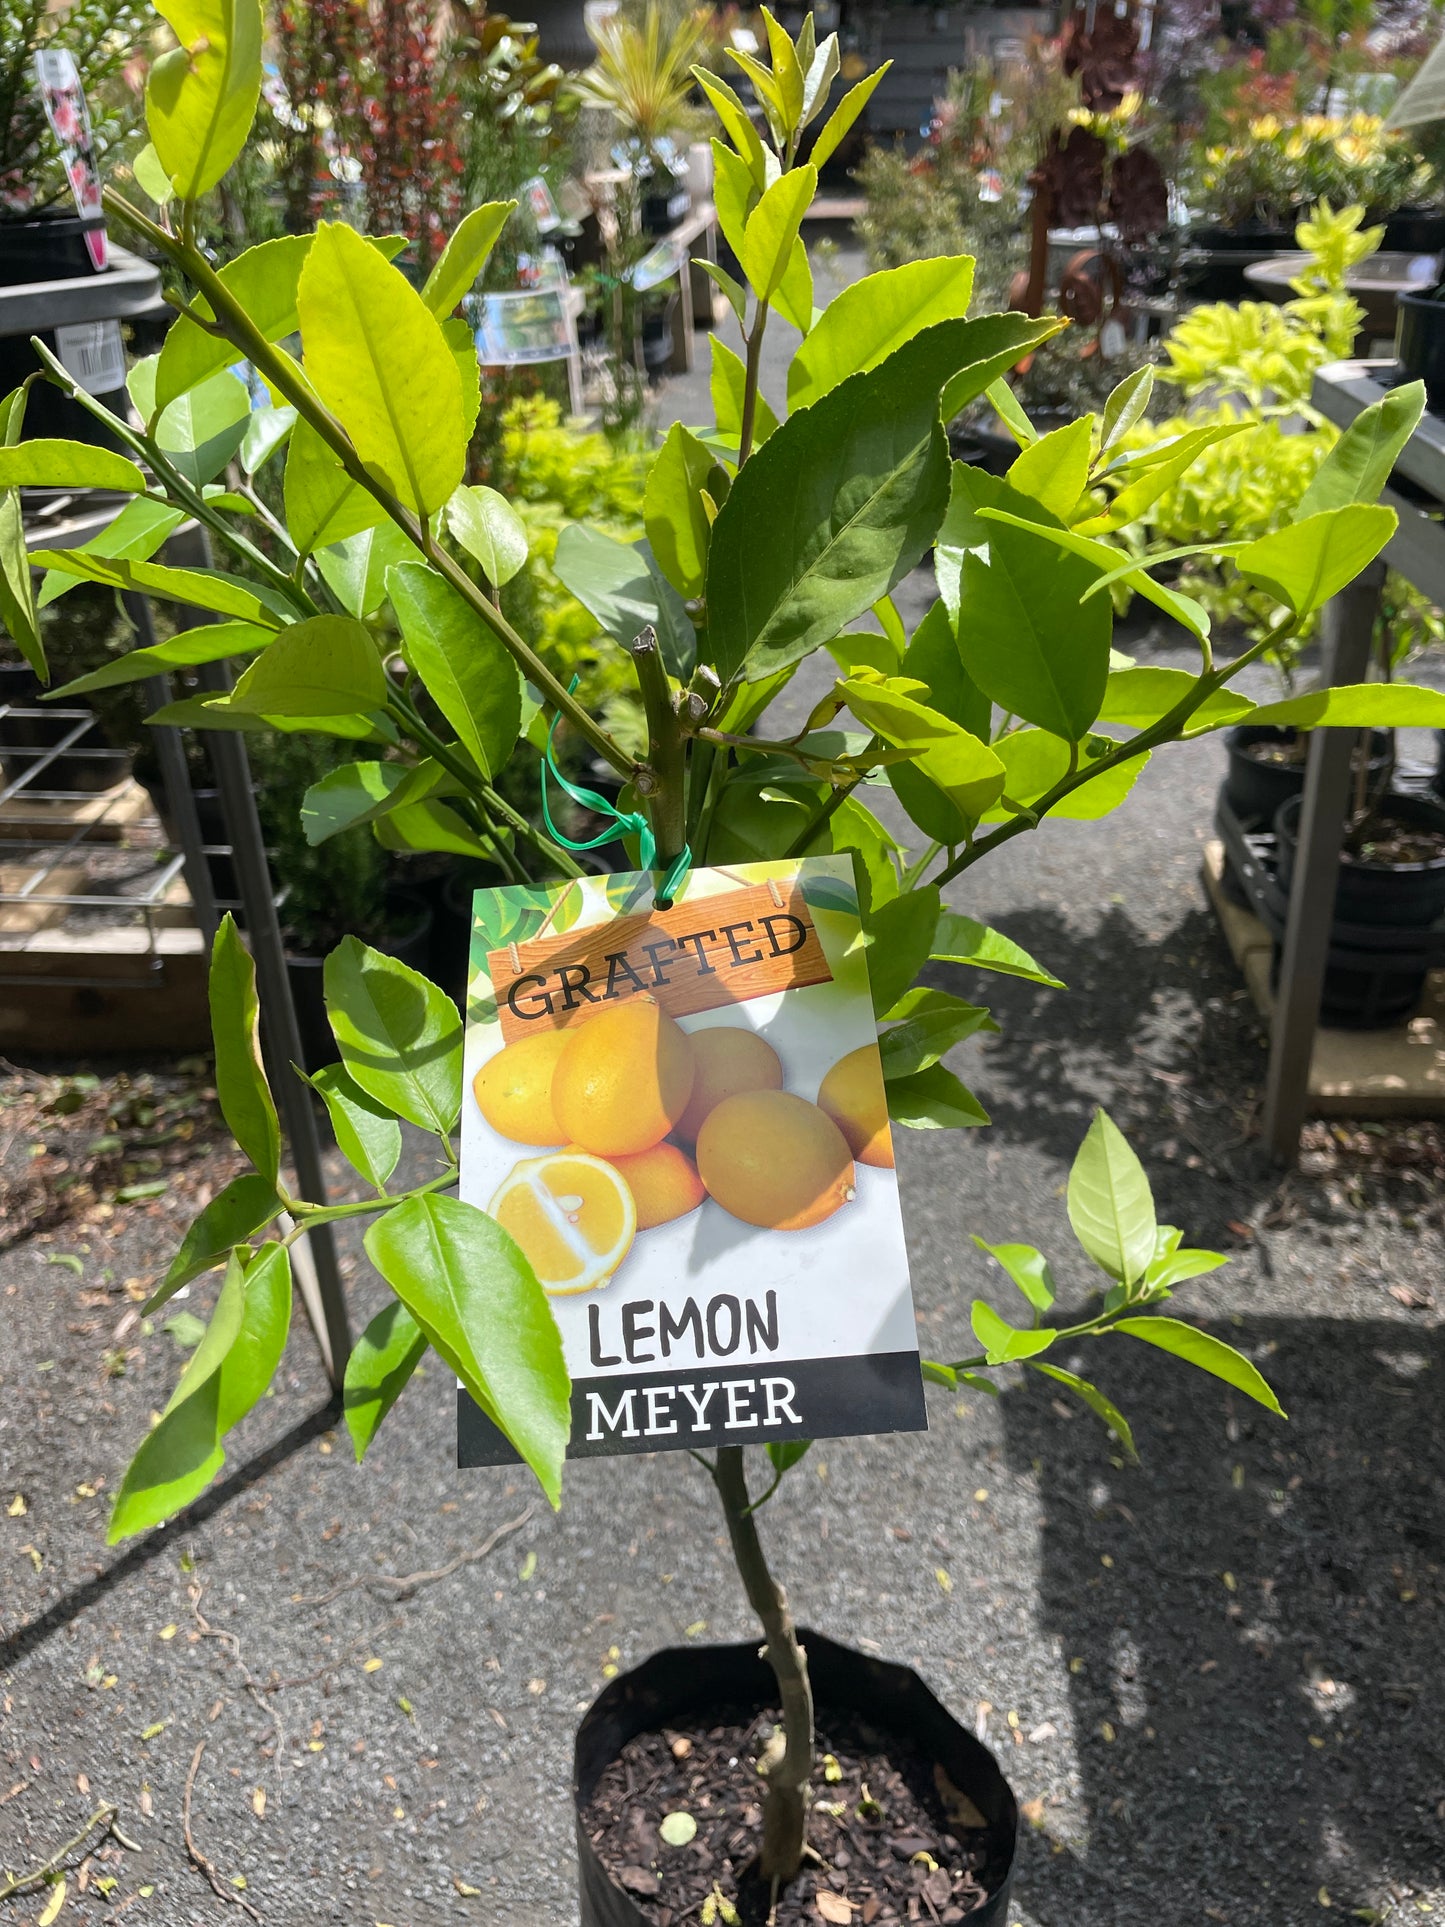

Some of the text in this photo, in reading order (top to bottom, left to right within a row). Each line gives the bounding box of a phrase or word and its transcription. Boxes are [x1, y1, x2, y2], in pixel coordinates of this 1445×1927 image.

[507, 914, 807, 1020] GRAFTED
[588, 1290, 779, 1367] LEMON
[586, 1376, 802, 1441] MEYER
